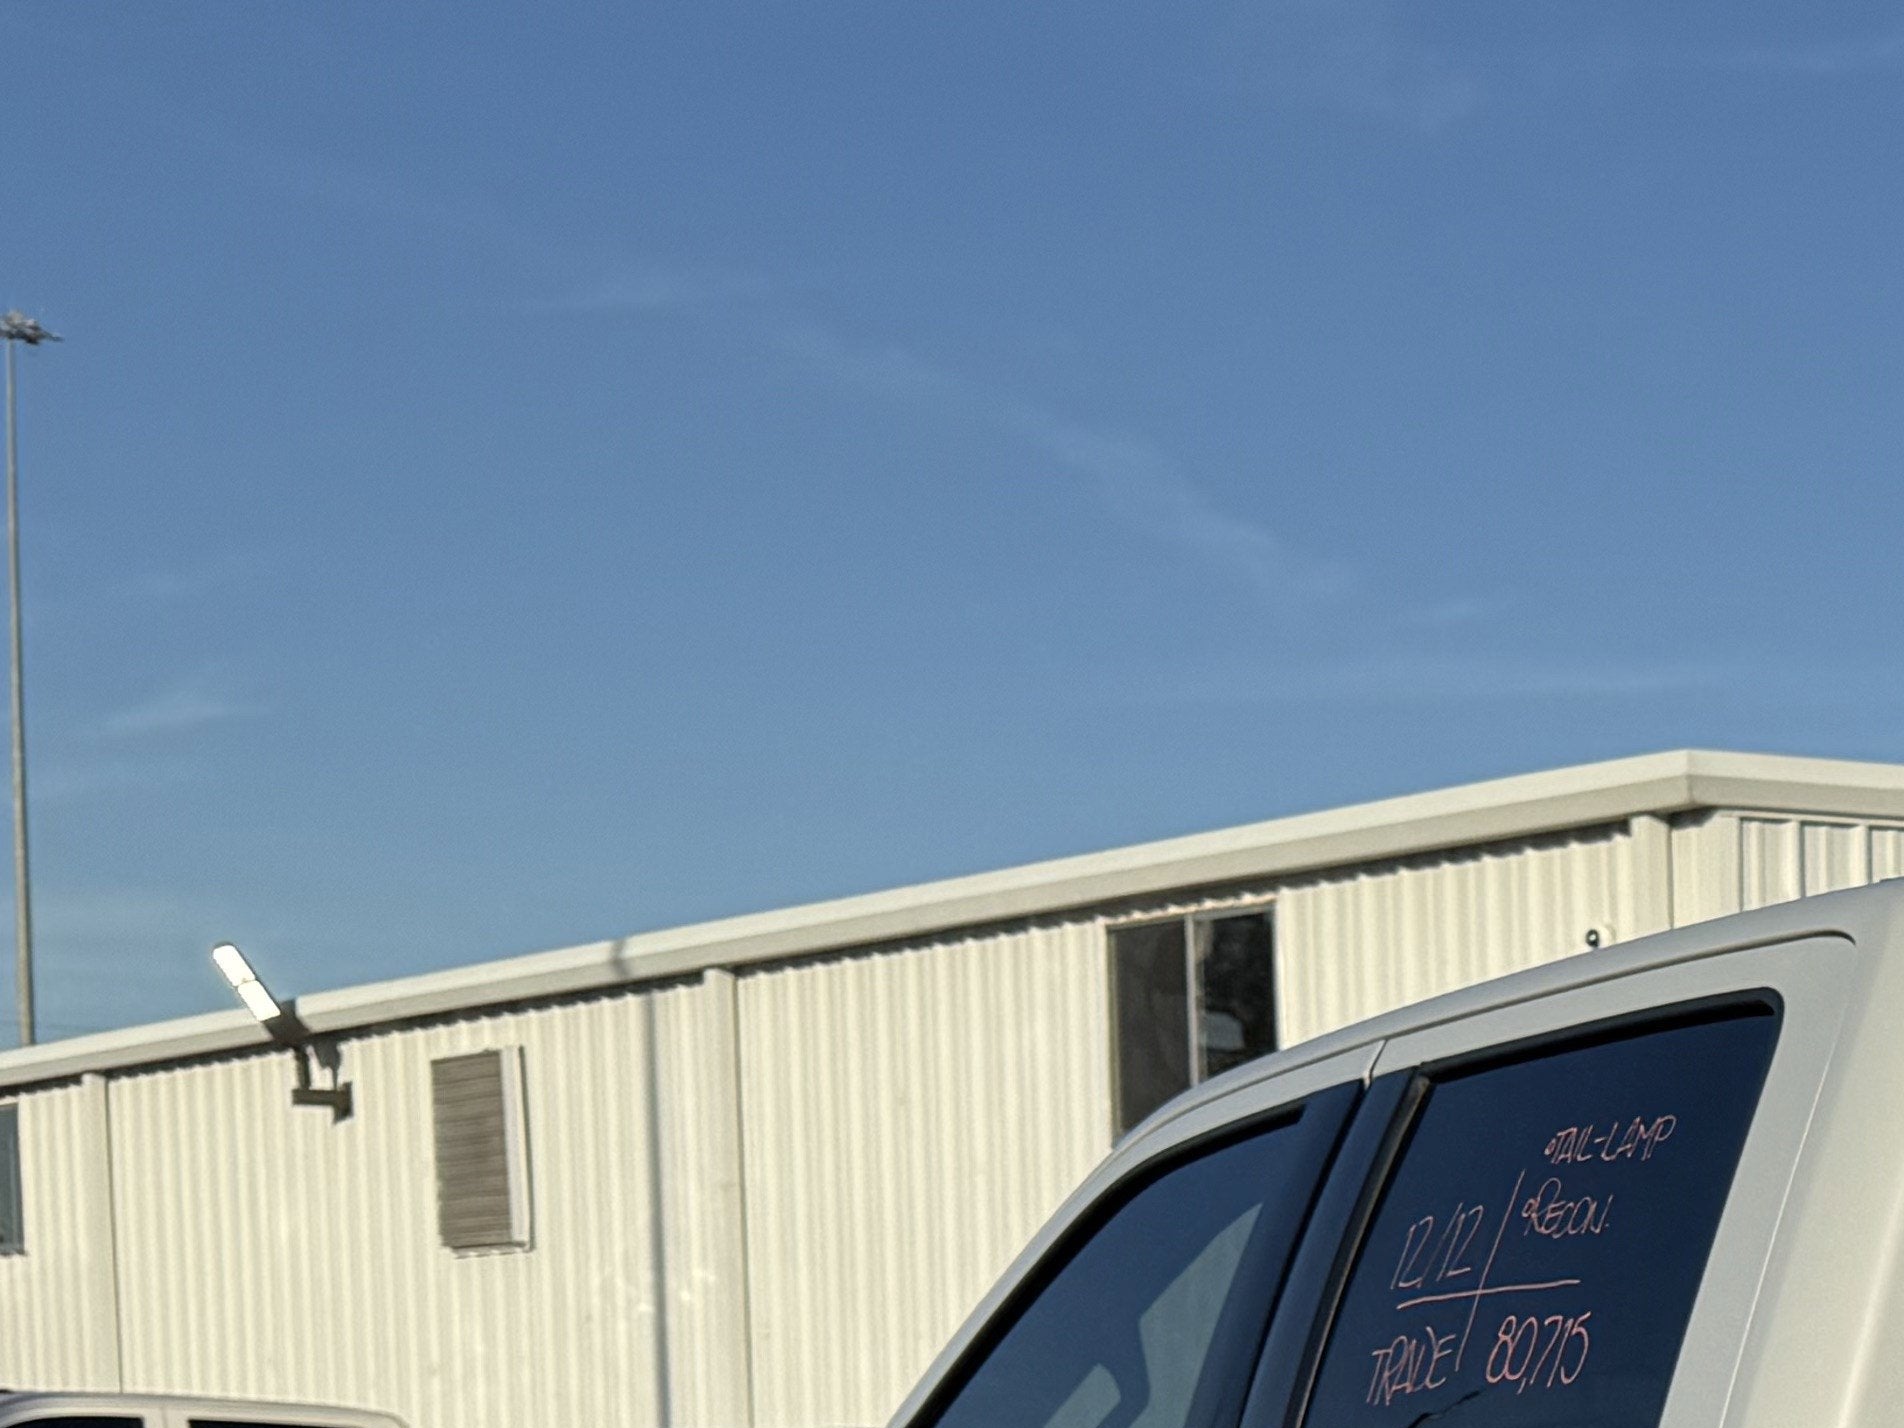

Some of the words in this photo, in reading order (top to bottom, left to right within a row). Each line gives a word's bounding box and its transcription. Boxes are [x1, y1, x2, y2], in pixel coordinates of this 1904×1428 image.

[1390, 1202, 1484, 1290] 12/12
[1366, 1326, 1457, 1407] TRADE
[1486, 1311, 1592, 1396] 80,715
